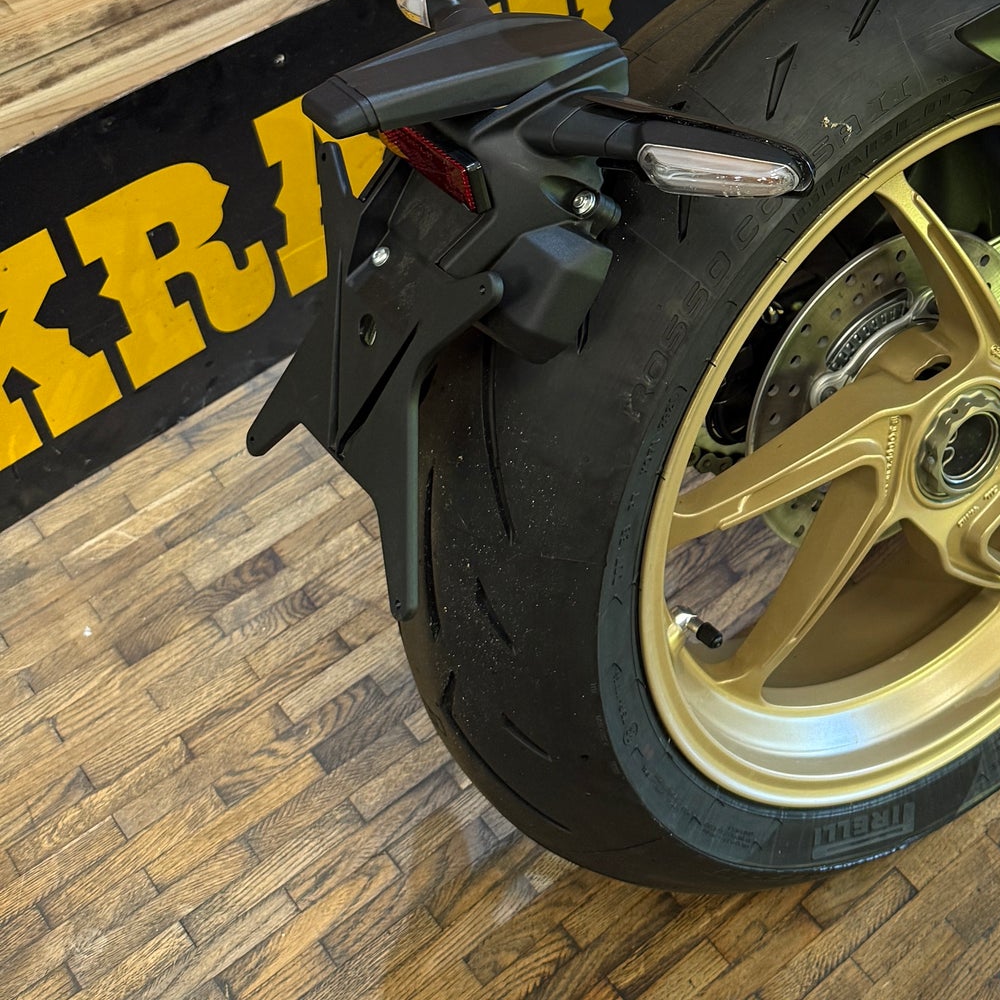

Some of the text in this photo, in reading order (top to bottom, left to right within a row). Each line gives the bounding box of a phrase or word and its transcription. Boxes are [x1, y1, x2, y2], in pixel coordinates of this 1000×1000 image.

[622, 250, 733, 424] ROSSO
[734, 113, 863, 252] COSA
[811, 801, 916, 860] PIRELLI
